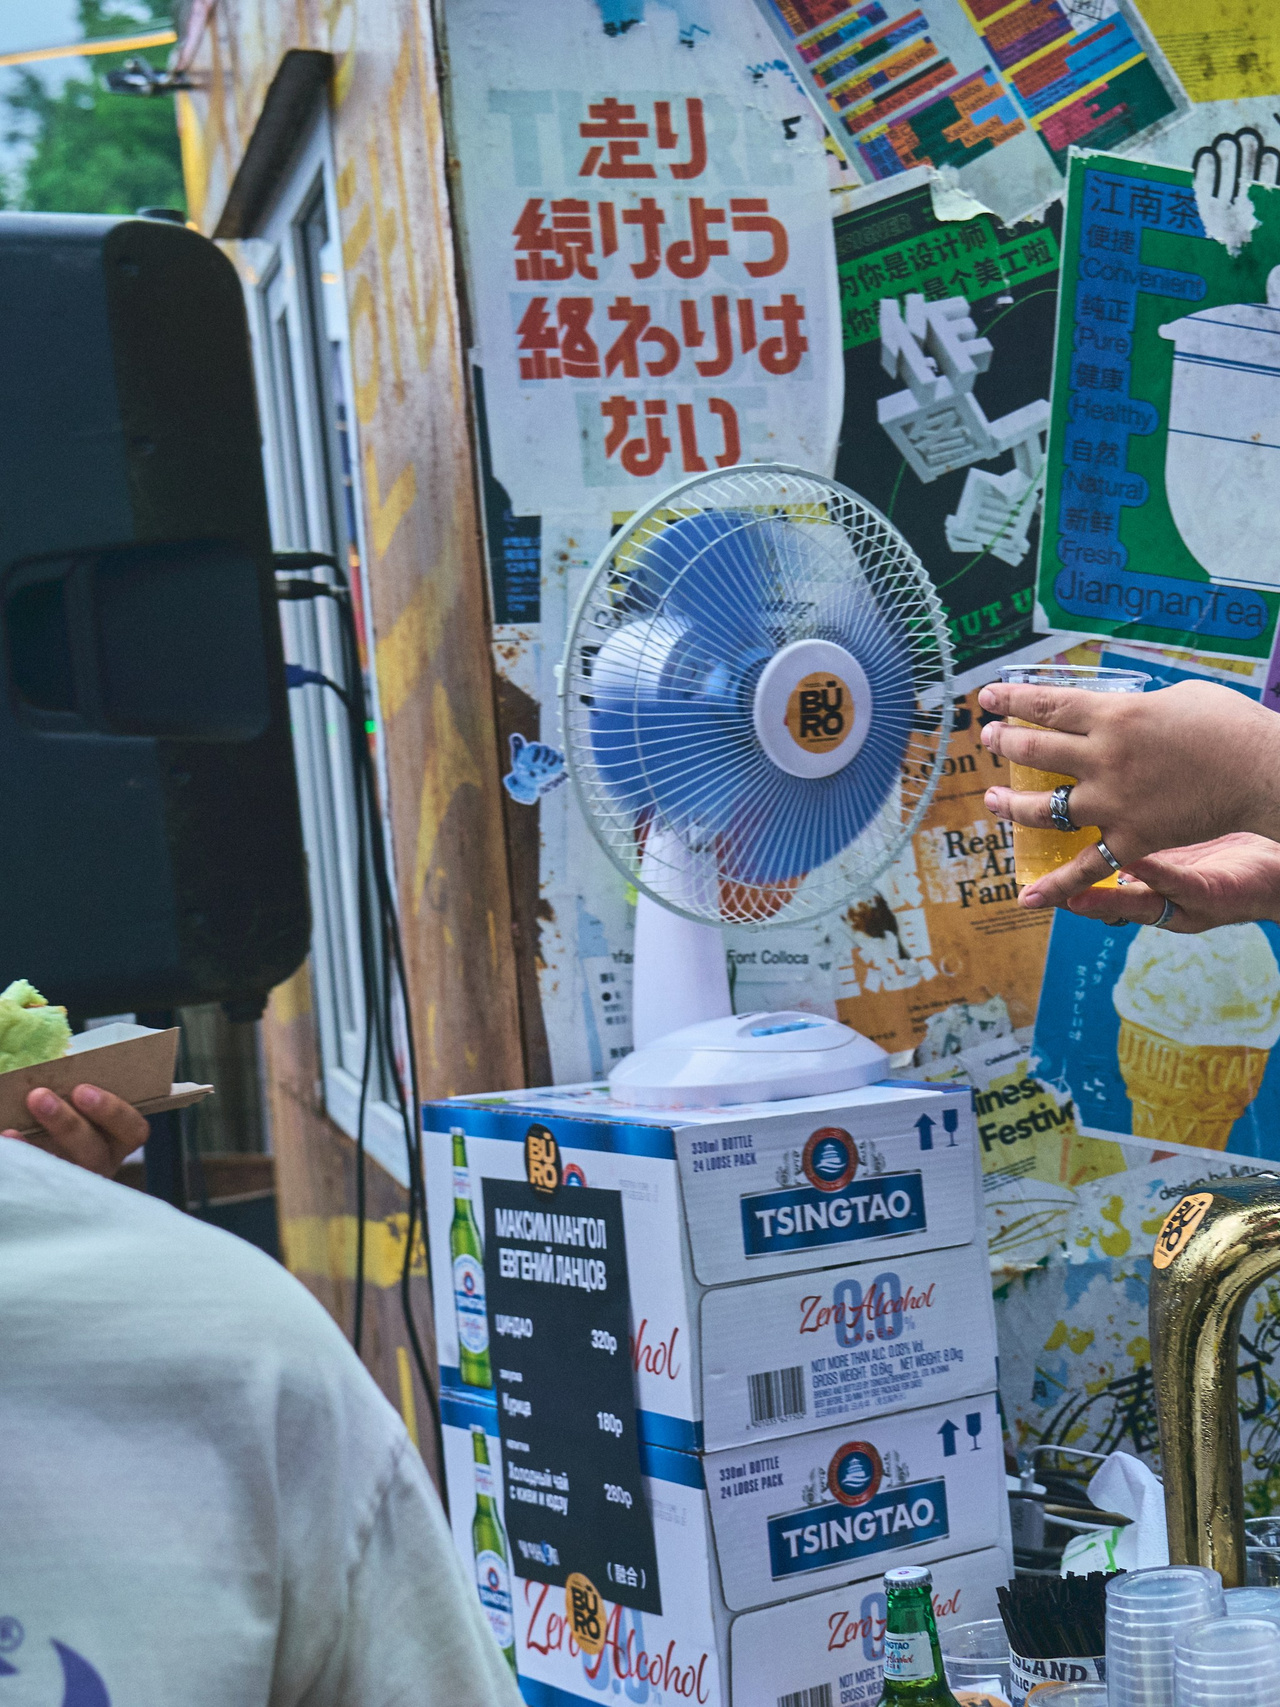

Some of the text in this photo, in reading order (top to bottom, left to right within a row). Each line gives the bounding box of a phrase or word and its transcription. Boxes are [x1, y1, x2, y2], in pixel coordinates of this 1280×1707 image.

[580, 97, 708, 180] 走り
[1090, 175, 1199, 229] 江南茶
[513, 197, 789, 281] 続けよう
[1084, 258, 1202, 295] Convenient
[517, 294, 809, 379] 終わりは
[1079, 326, 1129, 353] Pure
[1076, 363, 1123, 393] 健康
[1072, 400, 1152, 430] Healthy
[600, 396, 742, 477] ない
[1072, 438, 1118, 467] 自然
[1067, 471, 1144, 501] Natural
[1063, 540, 1120, 567] Fresh
[722, 1135, 753, 1152] BOTTLE
[693, 1152, 757, 1173] 24 LOOSE PACK
[495, 1207, 552, 1242] МАКСИМ
[754, 1189, 912, 1238] TSINGTAO
[499, 1246, 607, 1292] ЕВГЕНИЙ ЛАНЦОВ
[800, 1283, 936, 1334] Zero Alcohol
[844, 1326, 895, 1345] LAGER
[811, 1358, 826, 1373] NOT
[828, 1353, 850, 1370] MORE
[851, 1349, 871, 1366] THAN
[812, 1374, 838, 1388] GROSS
[901, 1357, 914, 1371] NET
[719, 1456, 780, 1482] 330ml BOTTLE
[604, 1483, 633, 1509] 280р
[721, 1473, 784, 1500] 24 LOOSE PACK
[782, 1498, 935, 1558] TSINGTAO
[839, 1667, 876, 1689] NOT MORE
[840, 1687, 863, 1704] GROSS
